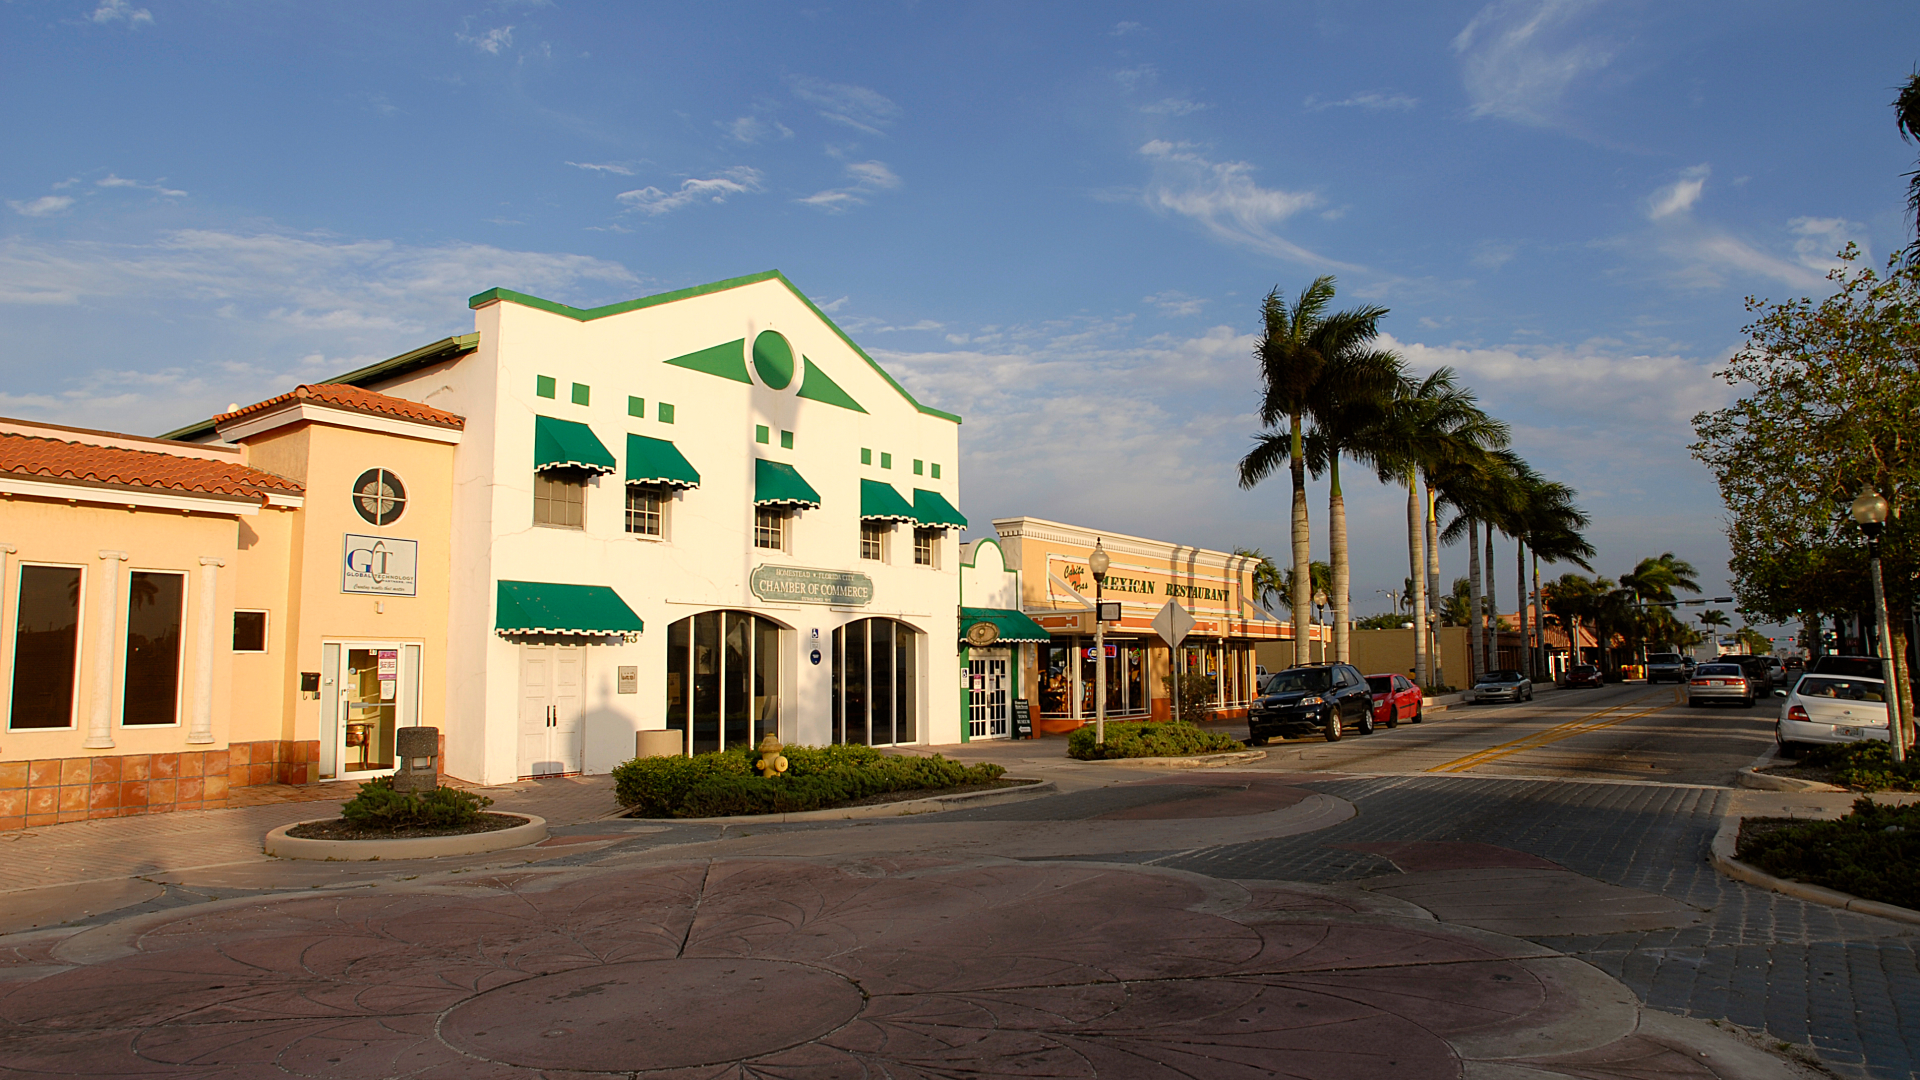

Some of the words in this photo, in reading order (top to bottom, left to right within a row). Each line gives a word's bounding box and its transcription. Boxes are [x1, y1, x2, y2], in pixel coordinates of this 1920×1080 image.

[775, 568, 811, 578] HOMESTEAD
[818, 572, 841, 580] FLORIDA
[759, 579, 806, 594] CHAMBER
[808, 583, 820, 595] OF
[820, 584, 869, 598] COMMERCE
[1102, 575, 1156, 595] MEXICAN
[1165, 582, 1230, 602] RESTAURANT
